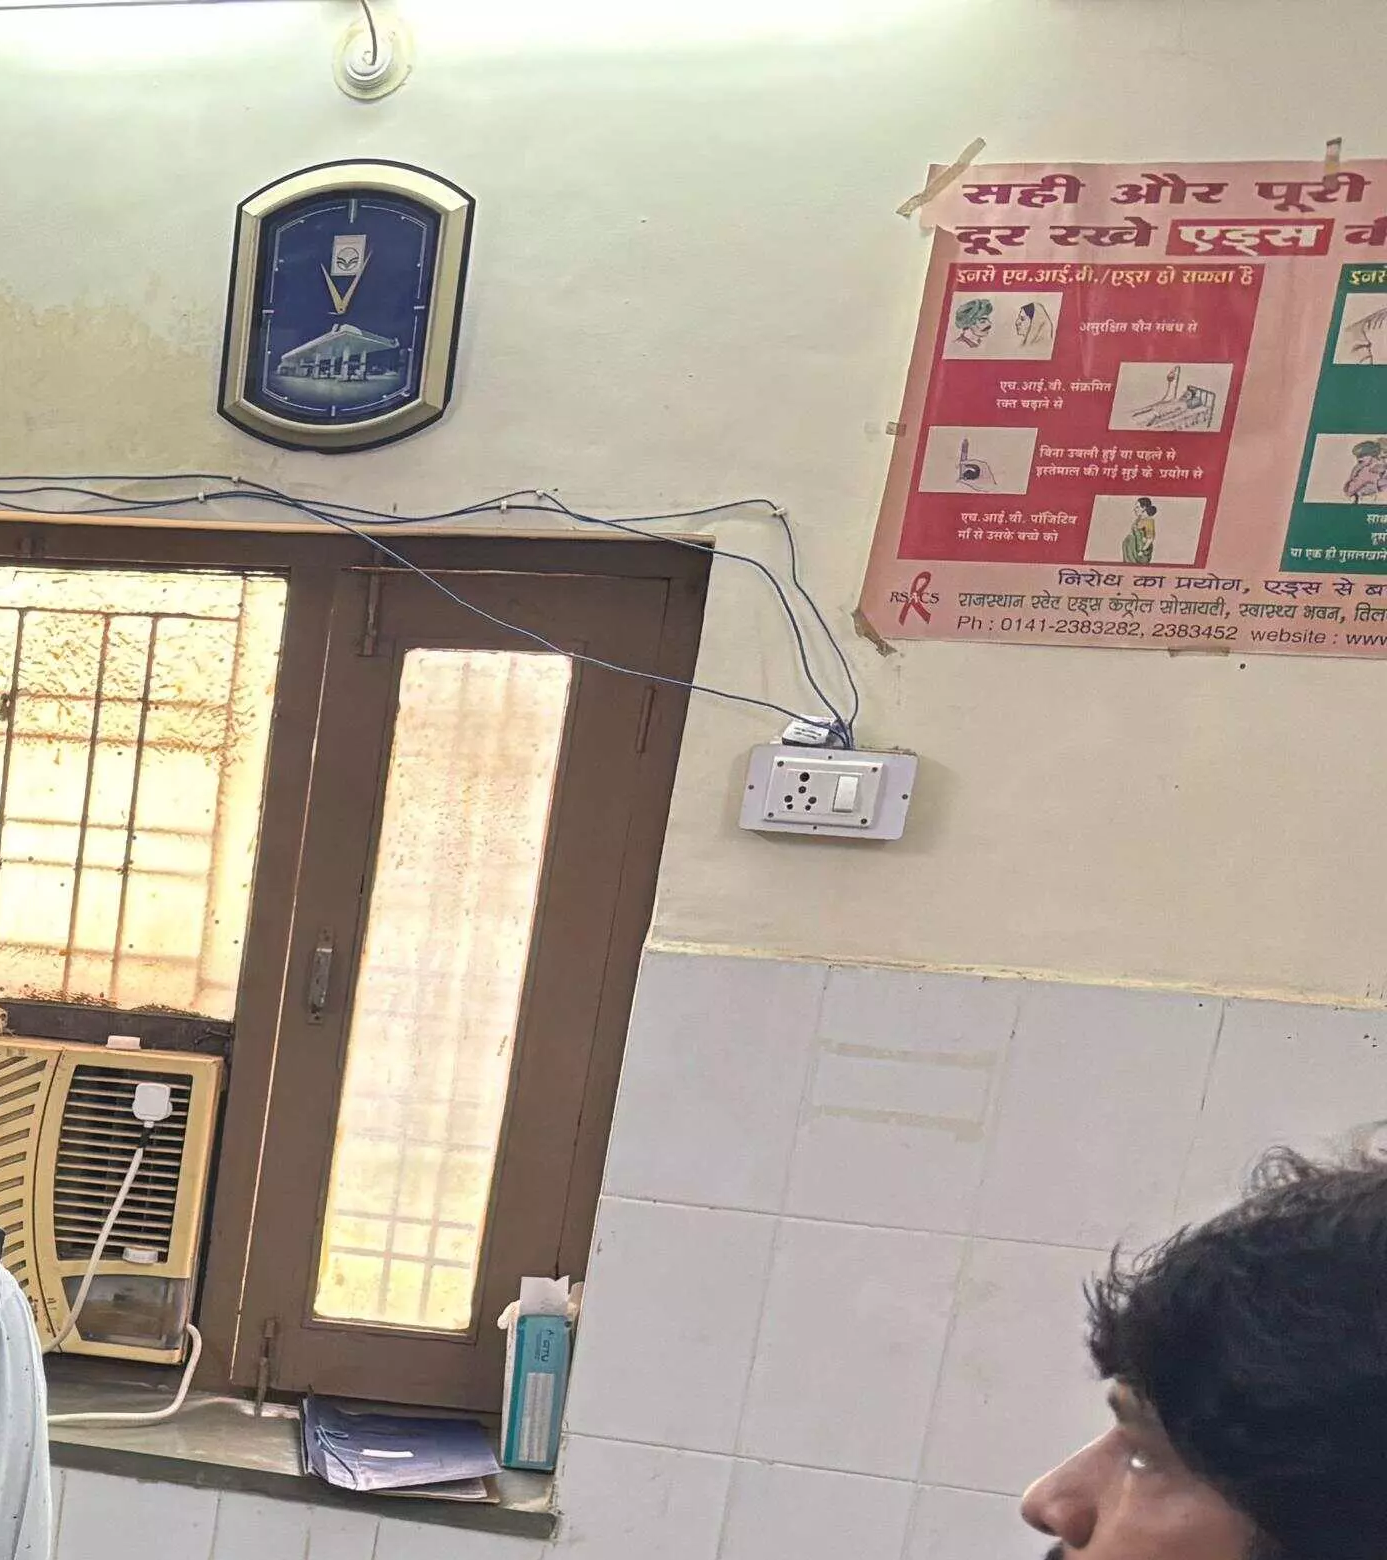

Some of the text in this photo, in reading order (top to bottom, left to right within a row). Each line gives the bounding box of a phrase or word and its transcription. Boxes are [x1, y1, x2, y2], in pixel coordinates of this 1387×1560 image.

[962, 172, 1371, 213] सही और पूरी
[954, 225, 1030, 256] दूर
[1178, 223, 1324, 256] एड्स
[955, 262, 1254, 286] इनसे हो सकता है
[1080, 319, 1127, 336] असुरक्षित
[1187, 321, 1198, 334] से
[1070, 380, 1112, 392] संक्रमित
[1053, 398, 1064, 409] से
[1039, 445, 1062, 458] बिना
[1120, 448, 1133, 460] या
[1136, 448, 1164, 461] पहले
[1166, 449, 1177, 461] से
[1035, 463, 1079, 477] इस्तेमाल
[1083, 465, 1100, 477] की
[1159, 467, 1189, 480] प्रयोग
[1193, 468, 1204, 480] से
[973, 529, 984, 541] से
[987, 530, 1014, 541] उसके
[1043, 531, 1059, 542] को
[1290, 547, 1302, 558] या
[1305, 547, 1321, 559] एक
[1058, 568, 1124, 588] निरोध
[1133, 575, 1166, 589] का
[1263, 580, 1323, 599] एड्स
[1333, 577, 1355, 596] से
[958, 592, 1024, 610] राजस्थान
[1031, 590, 1060, 611] स्टेट
[1066, 595, 1102, 616] एड्स
[1108, 592, 1152, 617] कंट्रोल
[1239, 603, 1296, 619] स्वास्थ्य
[957, 615, 1326, 645] Ph 0141-2383282, 2383452 website
